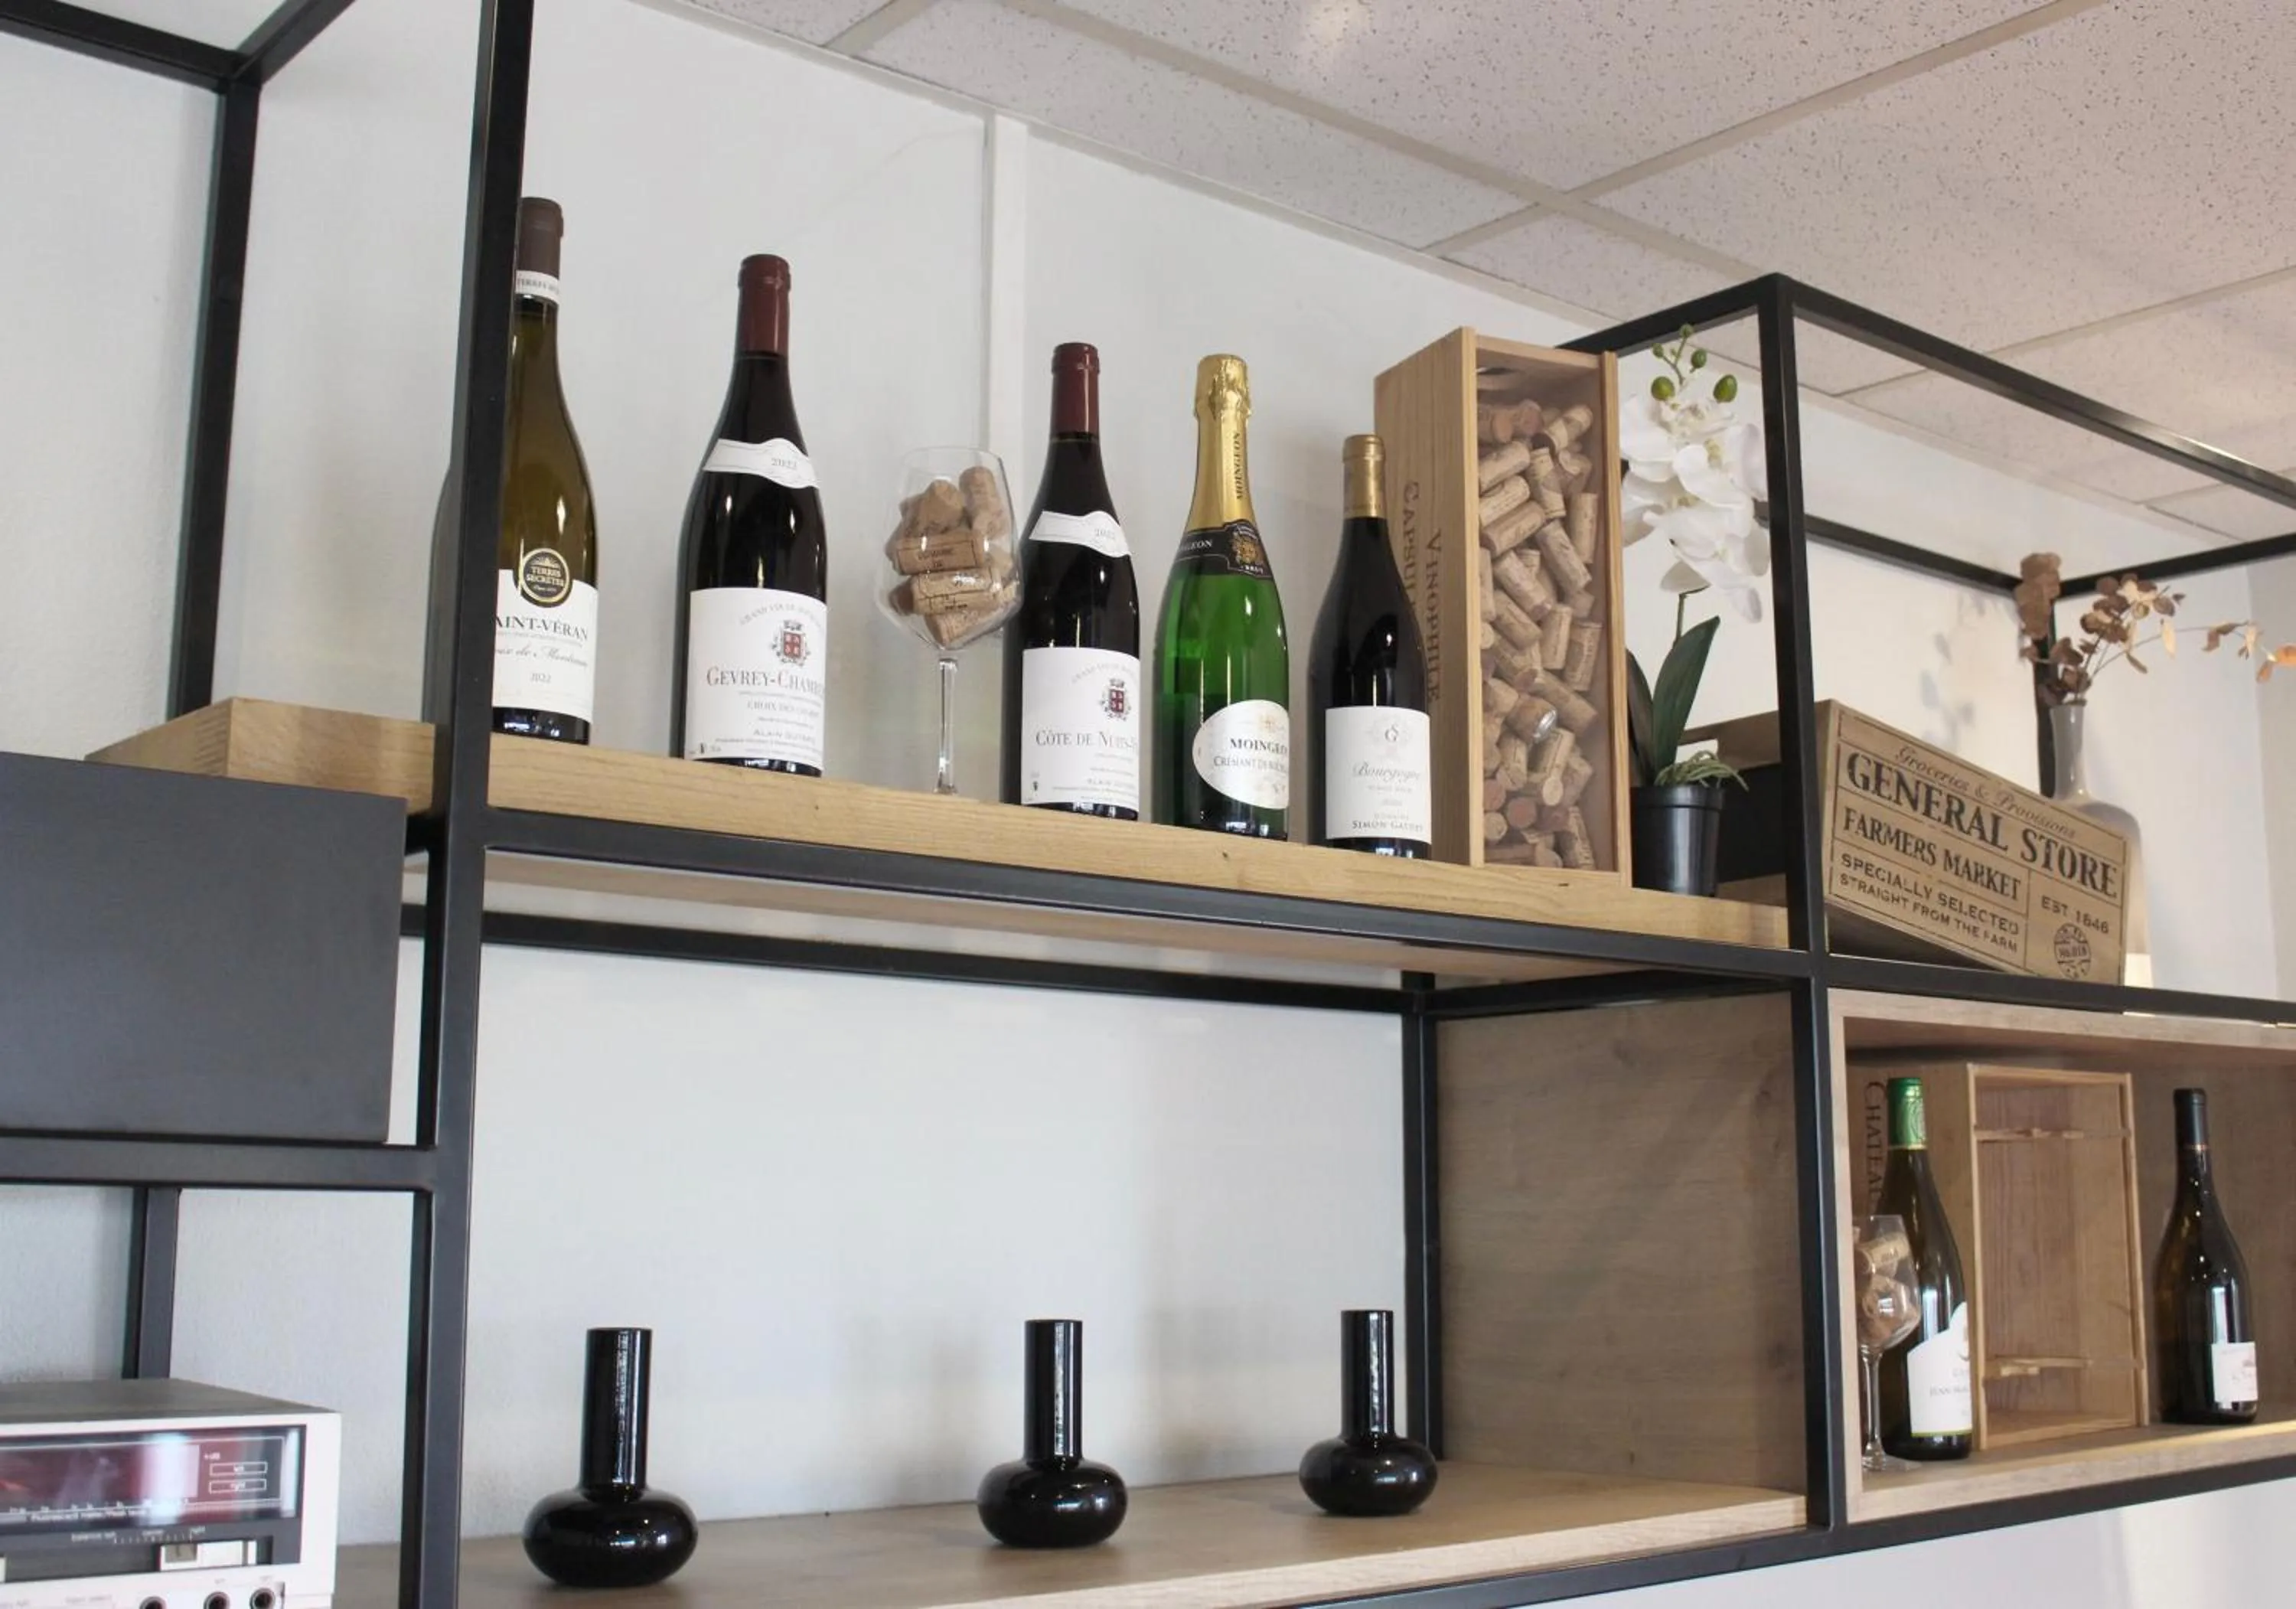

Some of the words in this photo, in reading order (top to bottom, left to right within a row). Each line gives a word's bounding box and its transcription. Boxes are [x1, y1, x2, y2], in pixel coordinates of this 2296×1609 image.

[1847, 752, 2008, 852] GENERAL
[2020, 828, 2118, 898] STORE
[1895, 744, 1971, 791] Groceries
[1975, 784, 1990, 799] &
[1993, 789, 2076, 840] Provisions
[1841, 852, 1933, 899] SPECIALLY
[1937, 892, 2019, 935] SELECTED
[1844, 806, 1937, 867] FARMERS
[1942, 847, 2021, 901] MARKET
[1840, 873, 1910, 908] STRAIGHT
[1912, 901, 1950, 926] FROM
[1951, 918, 1979, 938] THE
[1984, 933, 2018, 954] FARM
[2041, 895, 2069, 917] EST
